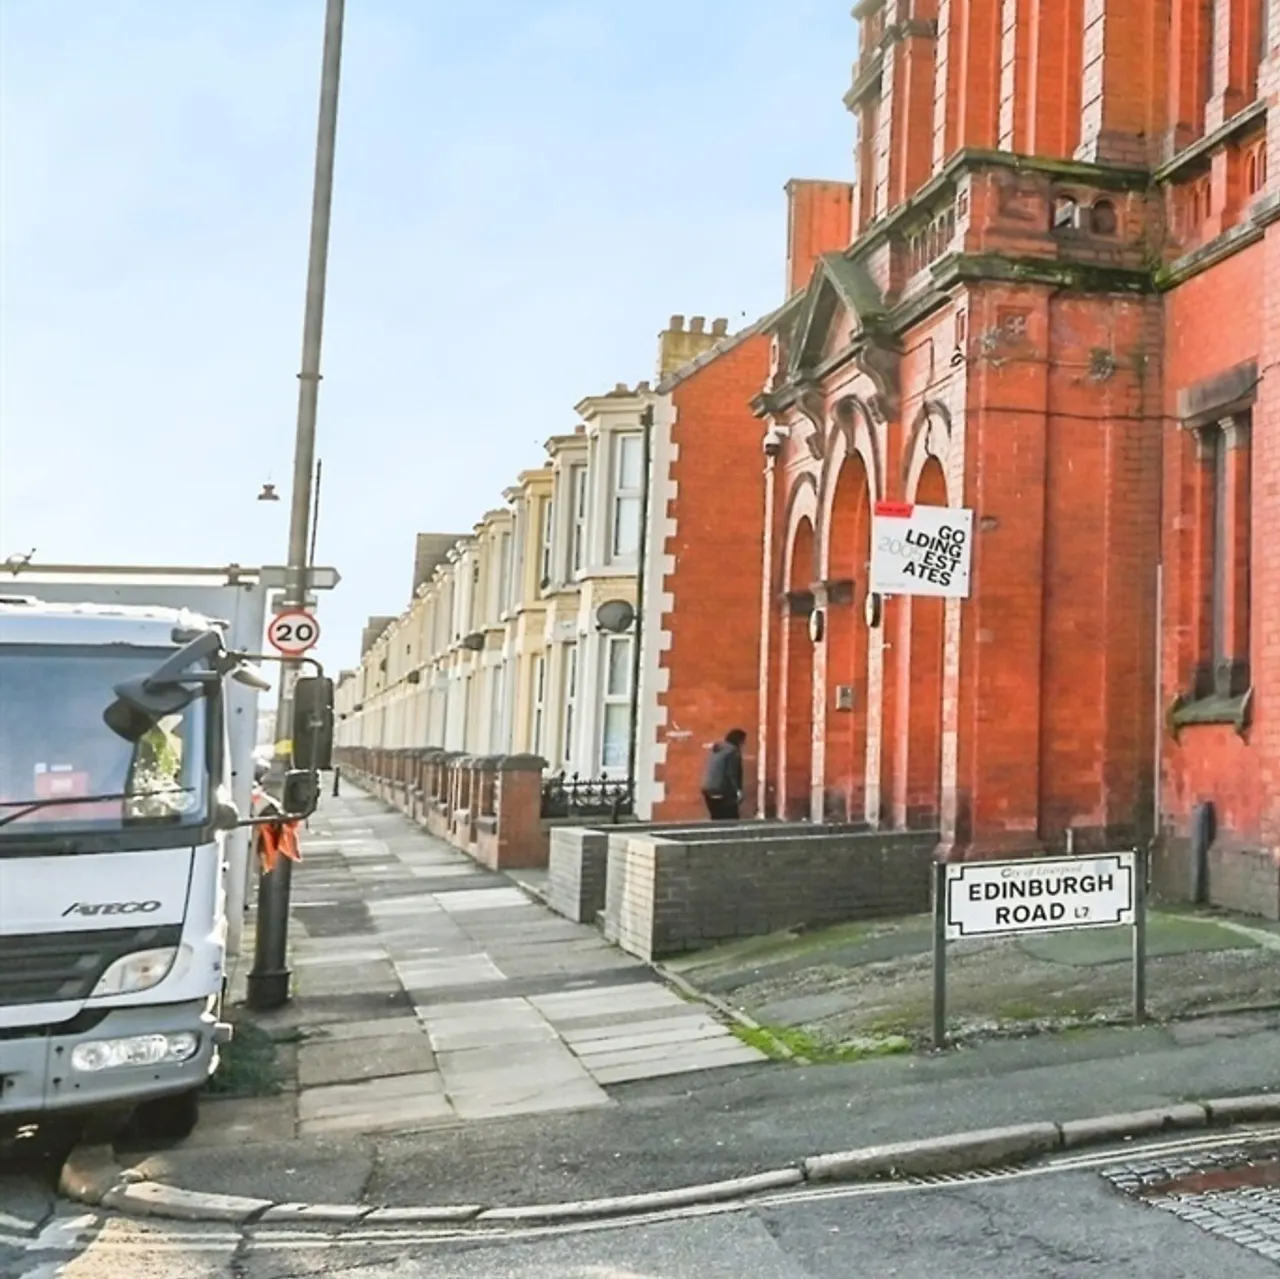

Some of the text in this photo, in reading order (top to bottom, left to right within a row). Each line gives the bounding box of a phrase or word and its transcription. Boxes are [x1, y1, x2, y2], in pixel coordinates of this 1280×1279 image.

[905, 529, 962, 558] LDING
[938, 525, 965, 544] GO
[923, 551, 961, 572] EST
[902, 561, 951, 587] ATES
[276, 623, 313, 642] 20
[969, 874, 1113, 901] EDINBURGH
[62, 900, 162, 917] ATEGO
[996, 902, 1090, 925] ROAD L7
